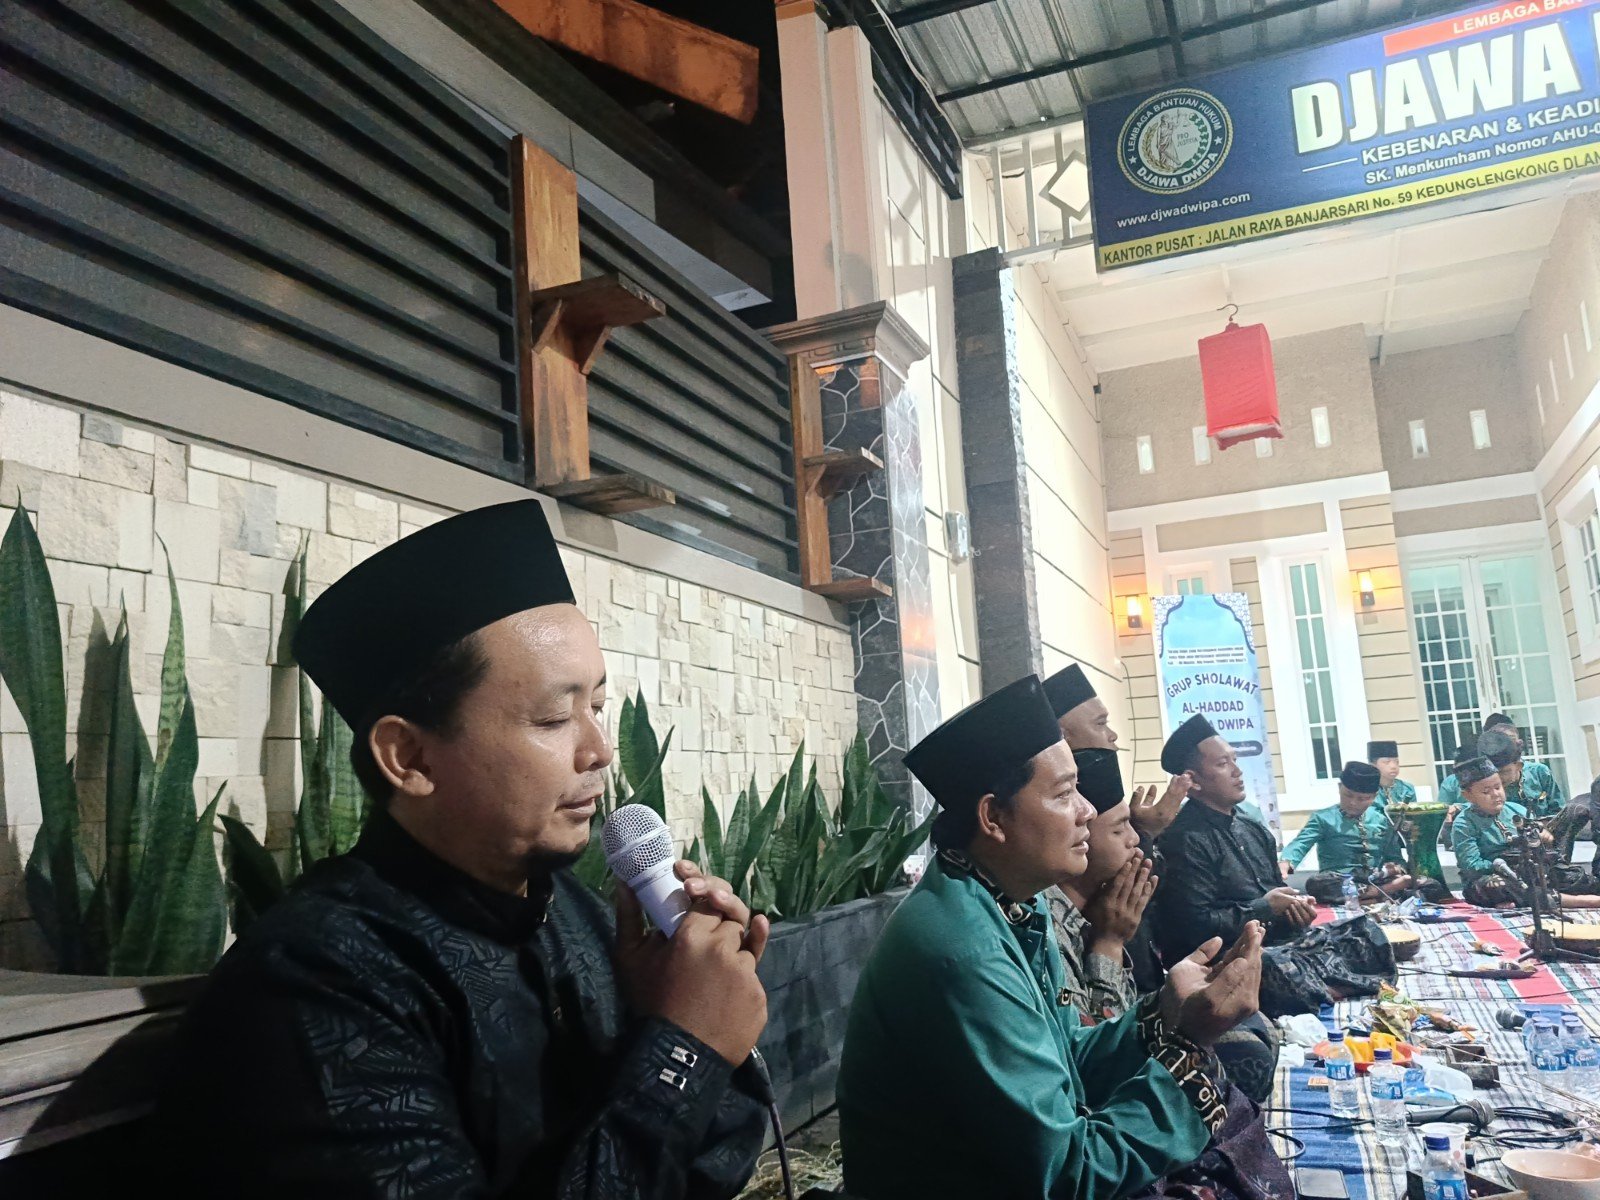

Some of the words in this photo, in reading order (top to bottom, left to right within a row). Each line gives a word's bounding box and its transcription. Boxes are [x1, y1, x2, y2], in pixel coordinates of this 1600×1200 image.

[1453, 3, 1540, 34] LEMBAGA
[1291, 22, 1582, 154] DJAWA
[1128, 111, 1153, 152] LEMBAGA
[1153, 98, 1199, 112] BANTUAN
[1199, 103, 1222, 130] HUKUM
[1362, 120, 1499, 164] KEBENARAN
[1505, 116, 1522, 133] &
[1136, 167, 1179, 187] DJAWA
[1181, 152, 1218, 185] DWIPA
[1365, 168, 1392, 184] SK.
[1395, 148, 1491, 178] Menkumham
[1494, 135, 1549, 156] Nomor
[1104, 243, 1153, 265] KANTOR
[1156, 235, 1195, 255] PUSAT
[1205, 224, 1247, 244] JALAN
[1250, 218, 1282, 235] RAYA
[1285, 198, 1370, 227] BANJARSARI
[1373, 195, 1394, 208] No.
[1398, 192, 1413, 204] 59
[1416, 160, 1559, 200] KEDUNGLENGKONG
[1117, 193, 1251, 228] www.djwadwipa.com
[1166, 677, 1192, 698] GRUP
[1194, 672, 1258, 695] SHOLAWAT
[1182, 700, 1244, 713] AL-HADDAD
[1217, 717, 1254, 730] DWIPA
